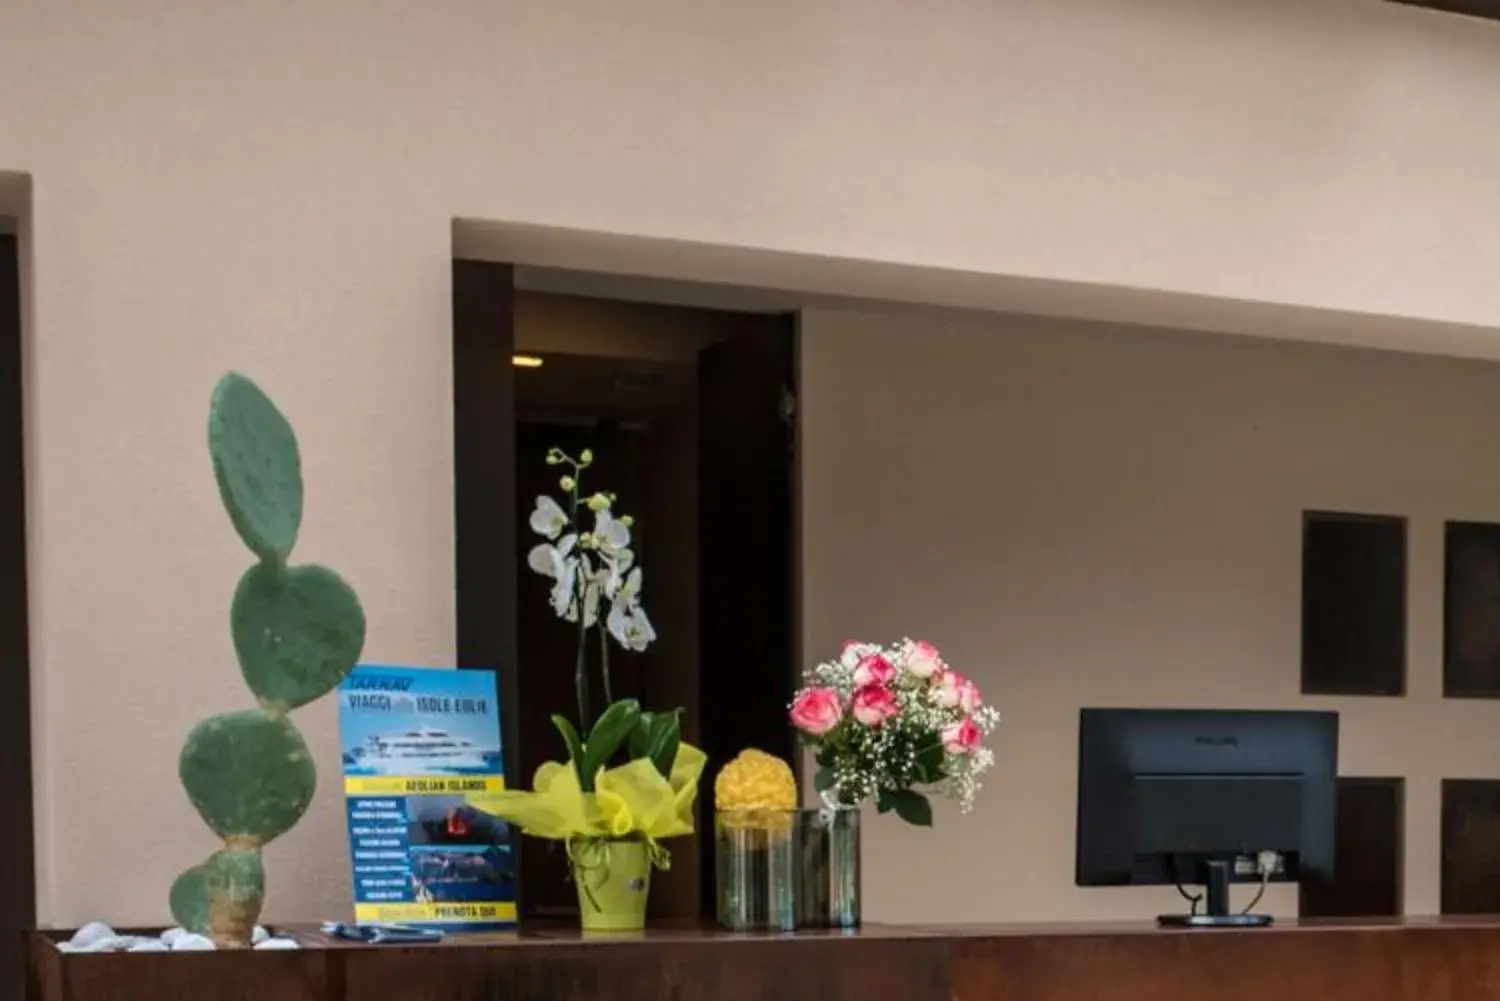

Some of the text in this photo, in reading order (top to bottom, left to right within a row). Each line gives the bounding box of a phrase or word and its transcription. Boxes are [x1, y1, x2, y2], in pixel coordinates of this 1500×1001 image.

[348, 694, 391, 711] VIAGGI
[416, 696, 449, 714] ISOLE
[405, 780, 444, 791] AEOLIAN
